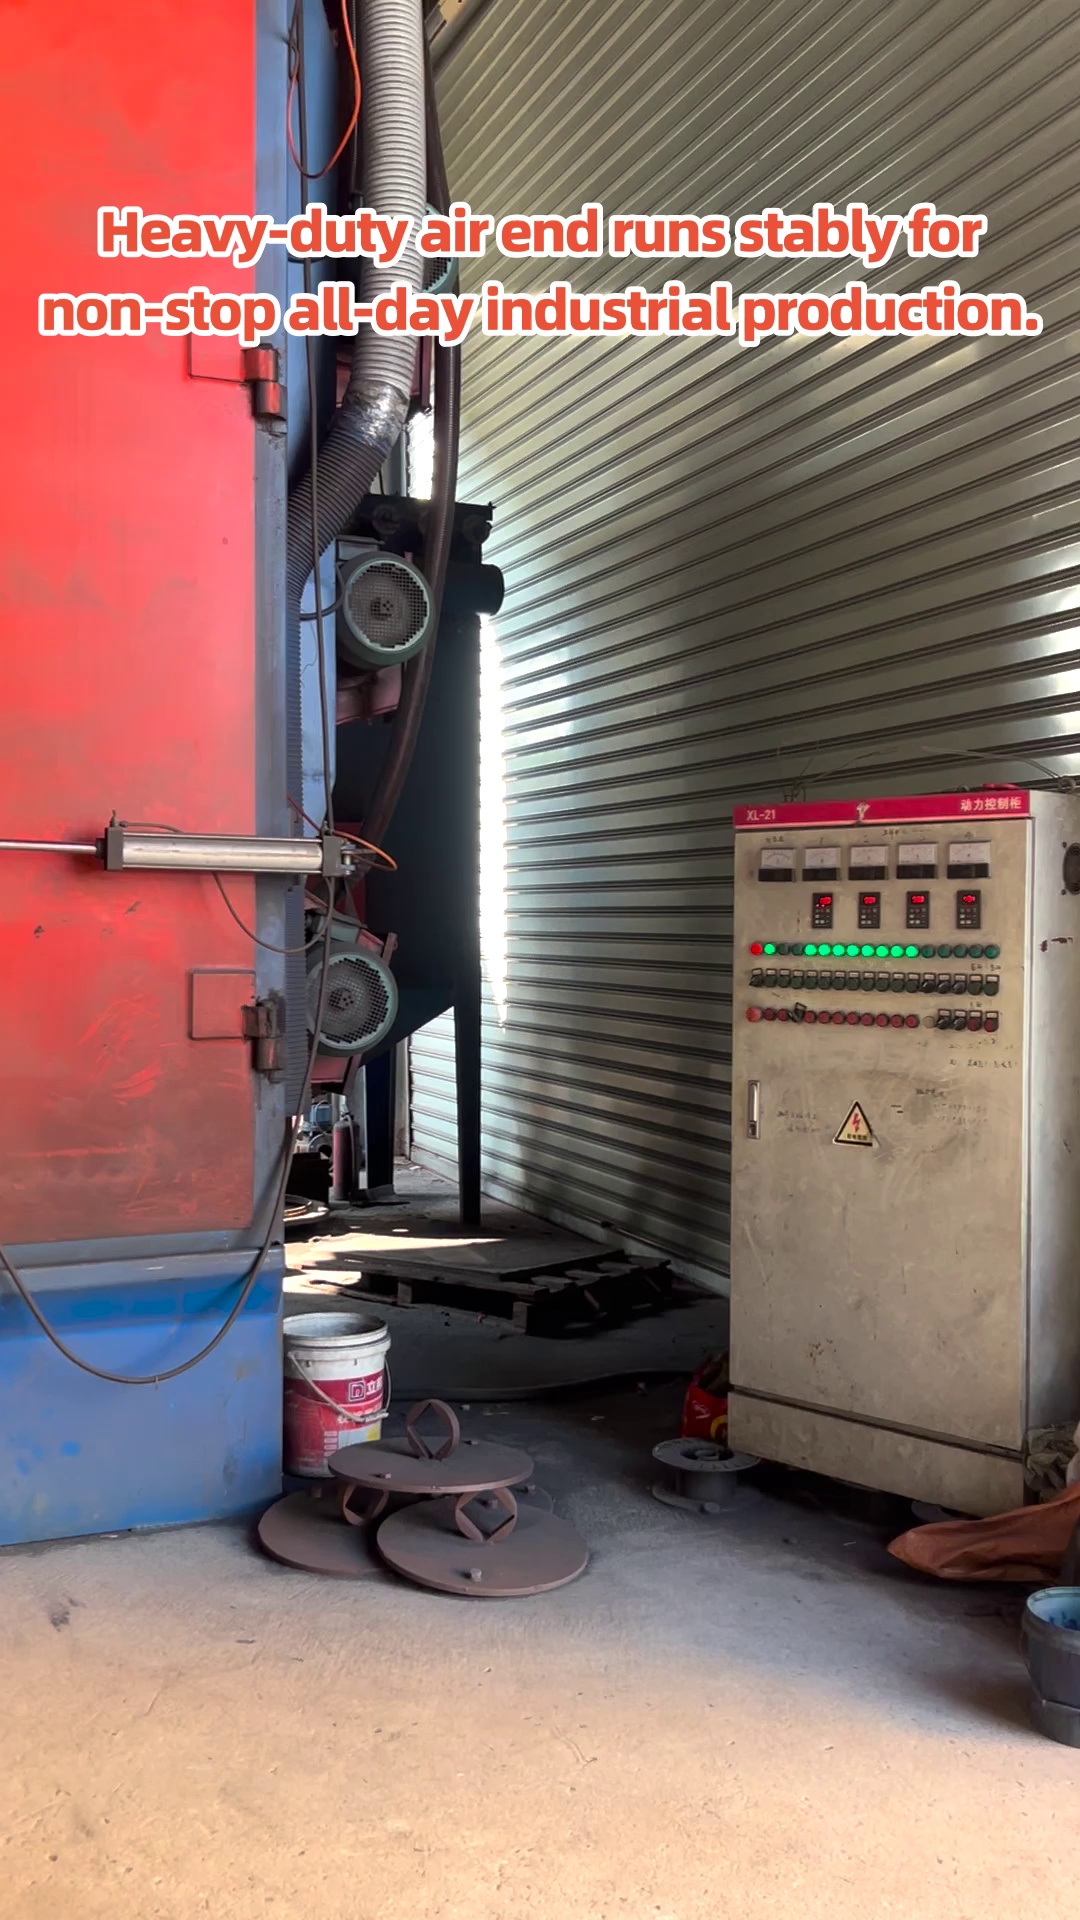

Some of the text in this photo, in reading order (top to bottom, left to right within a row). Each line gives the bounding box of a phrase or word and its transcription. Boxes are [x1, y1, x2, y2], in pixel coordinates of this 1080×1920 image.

[960, 796, 1023, 812] 动力控制柜
[745, 808, 777, 821] XL-21
